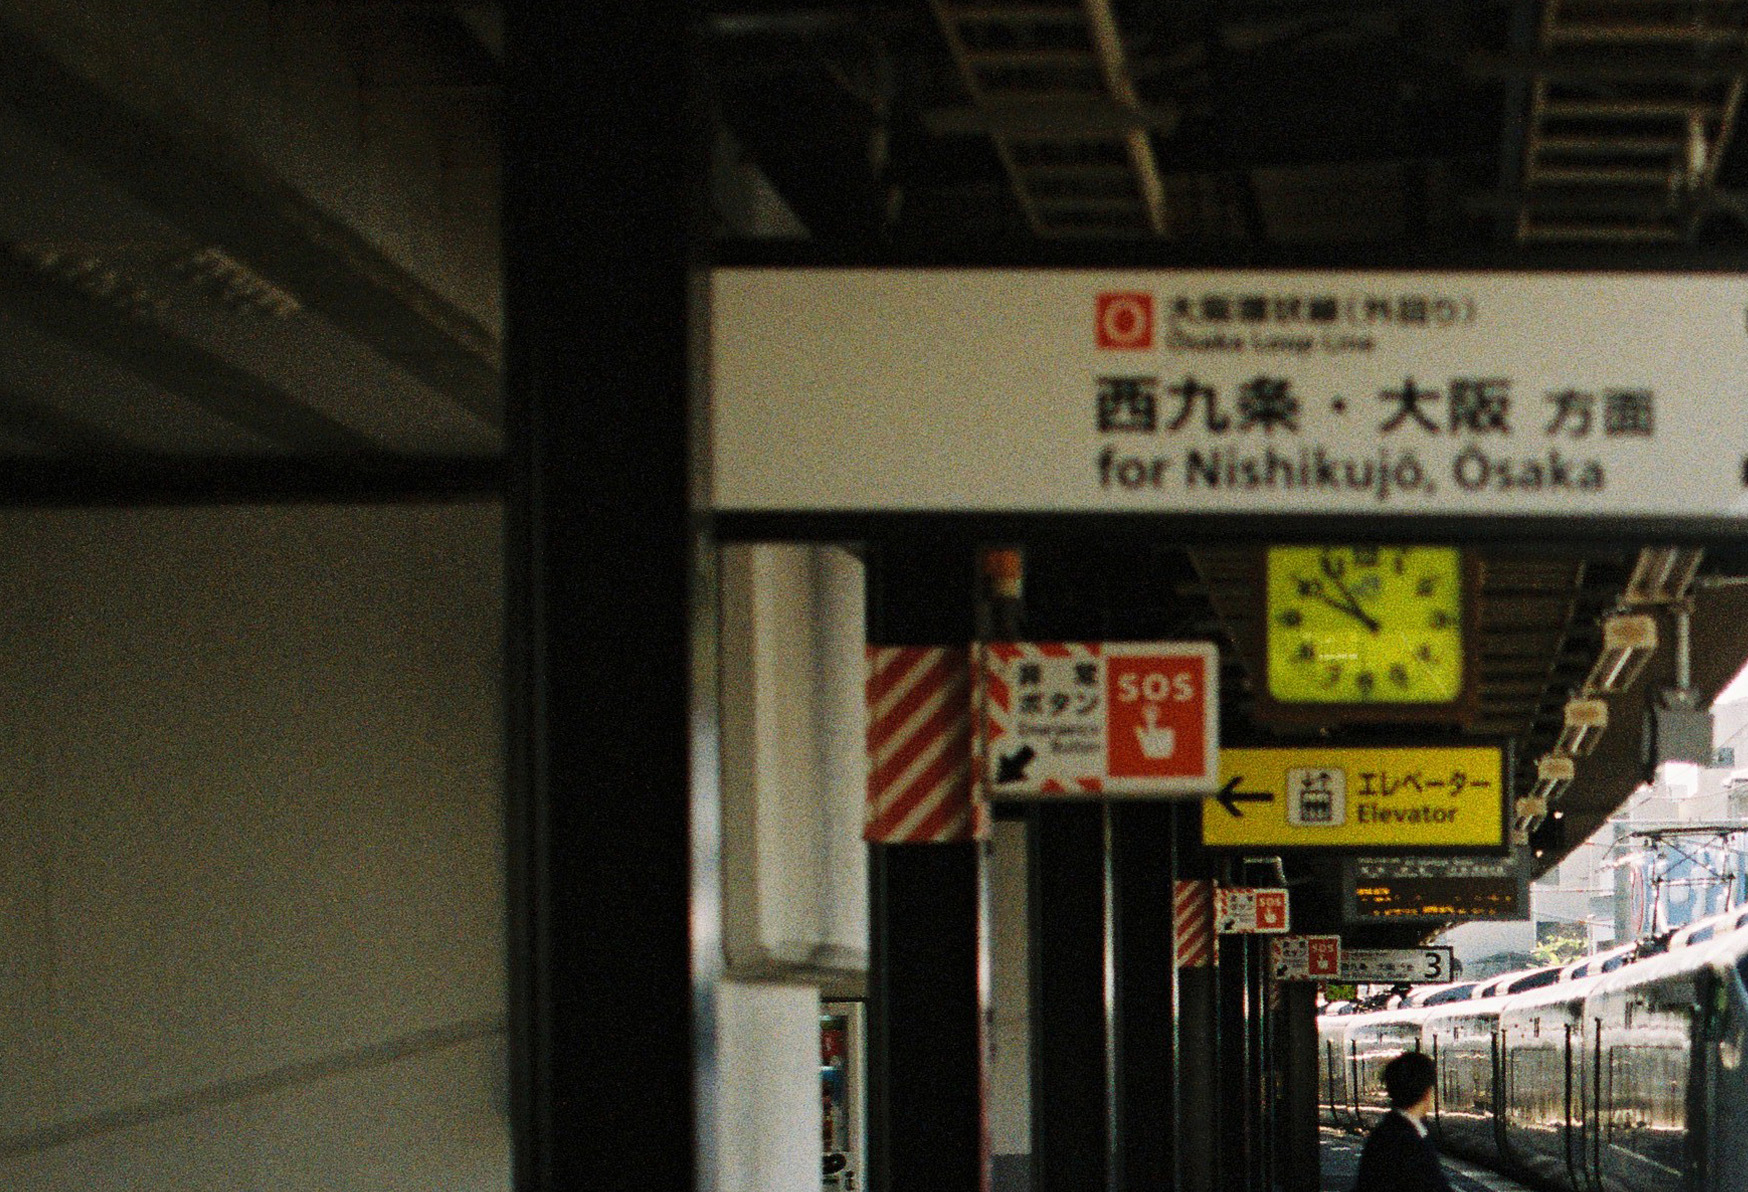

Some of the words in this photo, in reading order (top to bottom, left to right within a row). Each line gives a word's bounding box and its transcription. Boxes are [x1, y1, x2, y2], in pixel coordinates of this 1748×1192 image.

[1545, 387, 1656, 437] 方面
[1098, 446, 1168, 489] for
[1117, 671, 1194, 703] SOS
[1358, 771, 1491, 796] エレベーター
[1358, 804, 1458, 824] Elevator
[1424, 952, 1441, 978] 3
